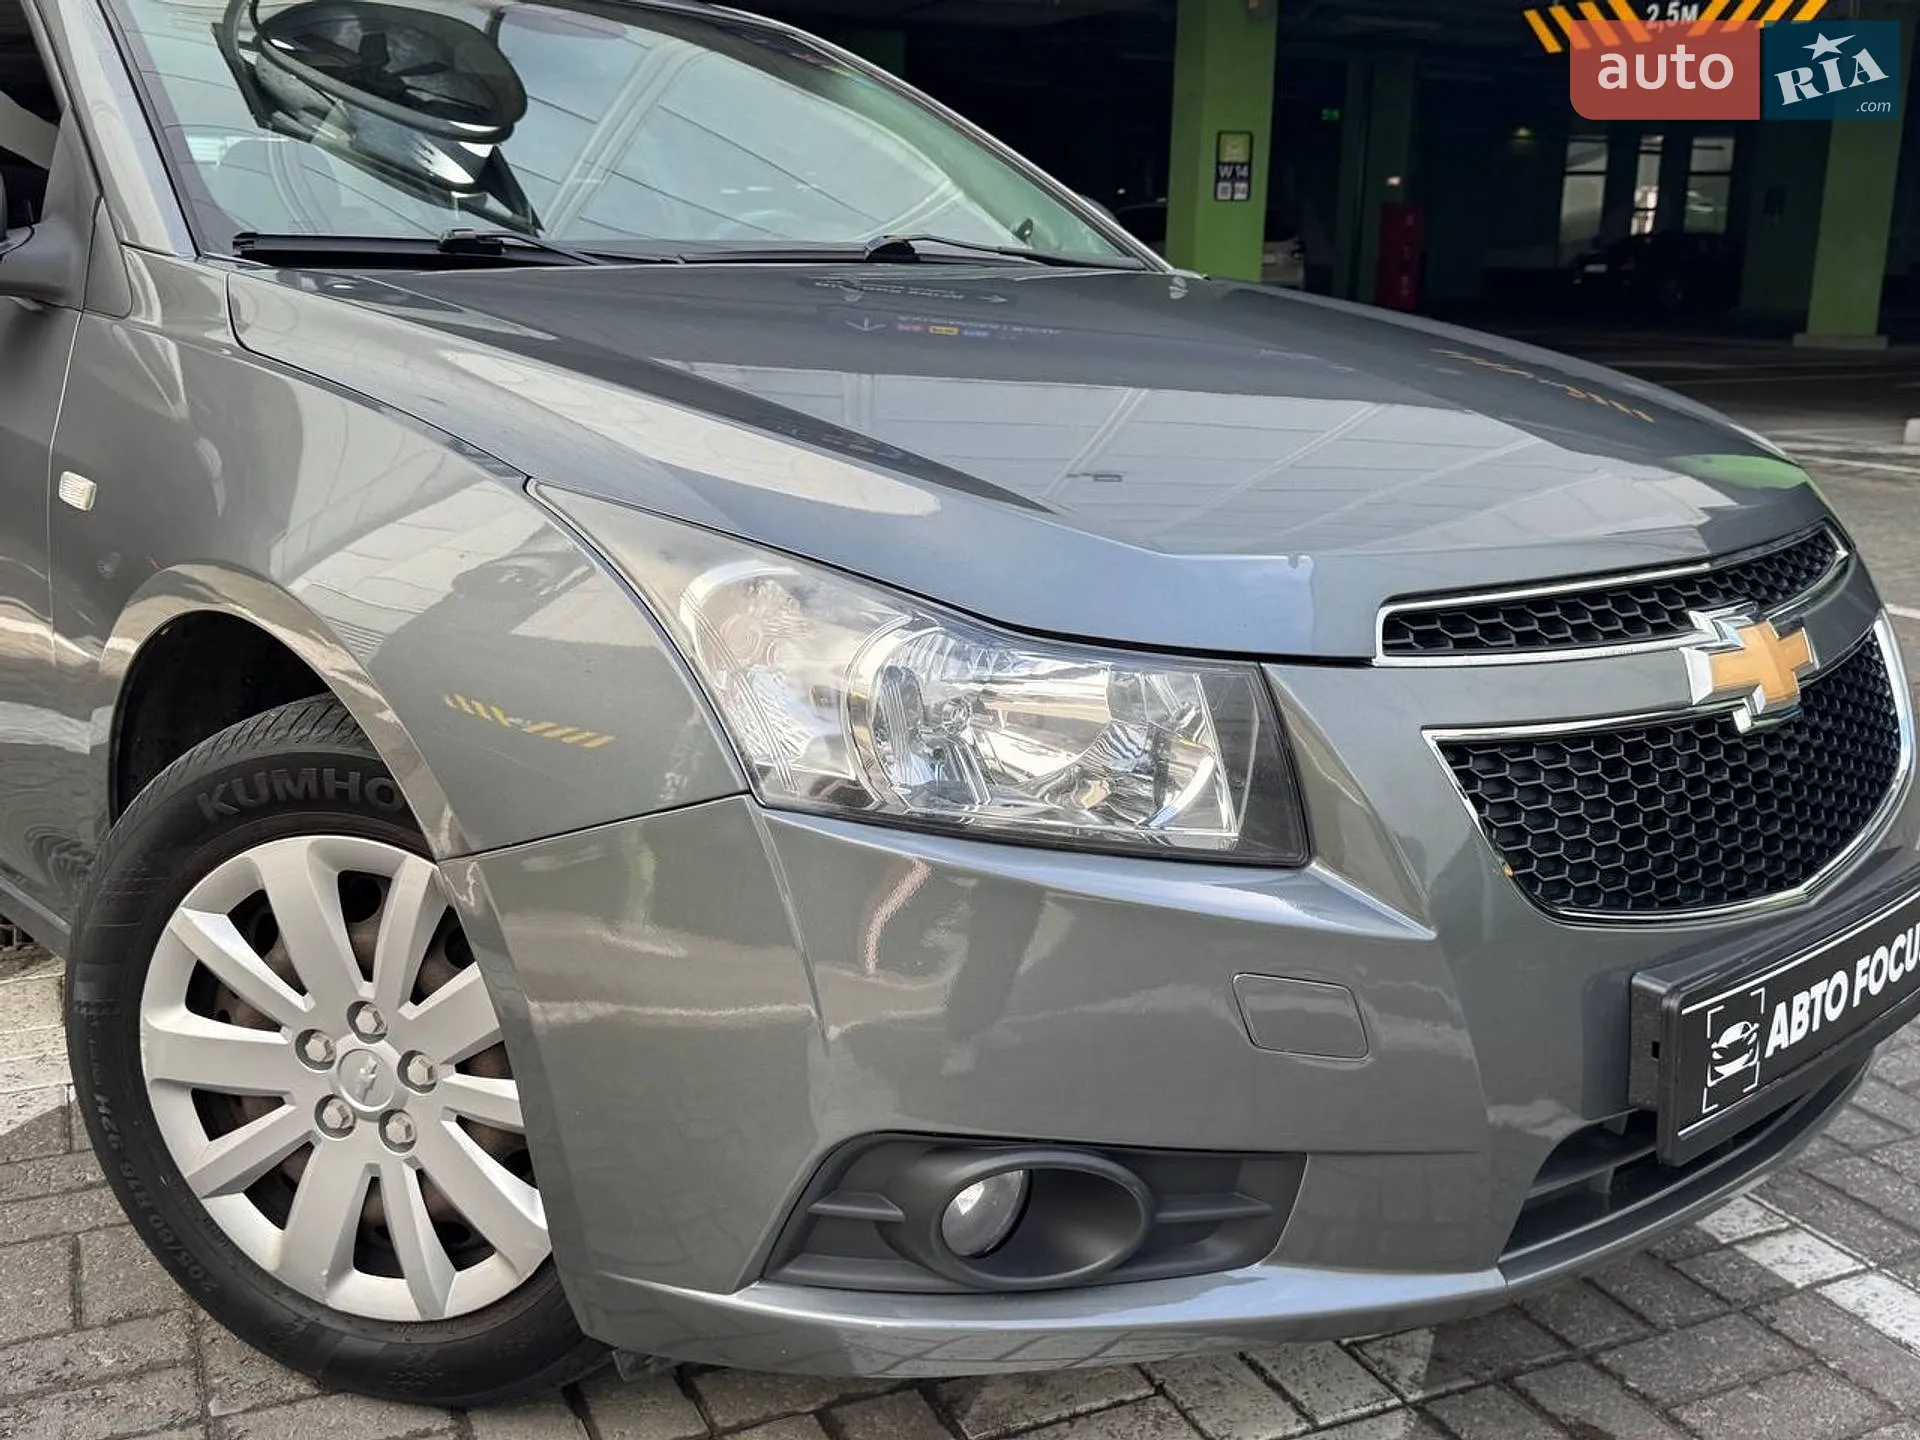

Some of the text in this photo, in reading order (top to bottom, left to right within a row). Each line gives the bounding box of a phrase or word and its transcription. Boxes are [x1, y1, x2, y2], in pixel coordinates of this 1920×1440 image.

[197, 767, 404, 823] KUMHO
[1765, 922, 1920, 1058] АВТО FOCU
